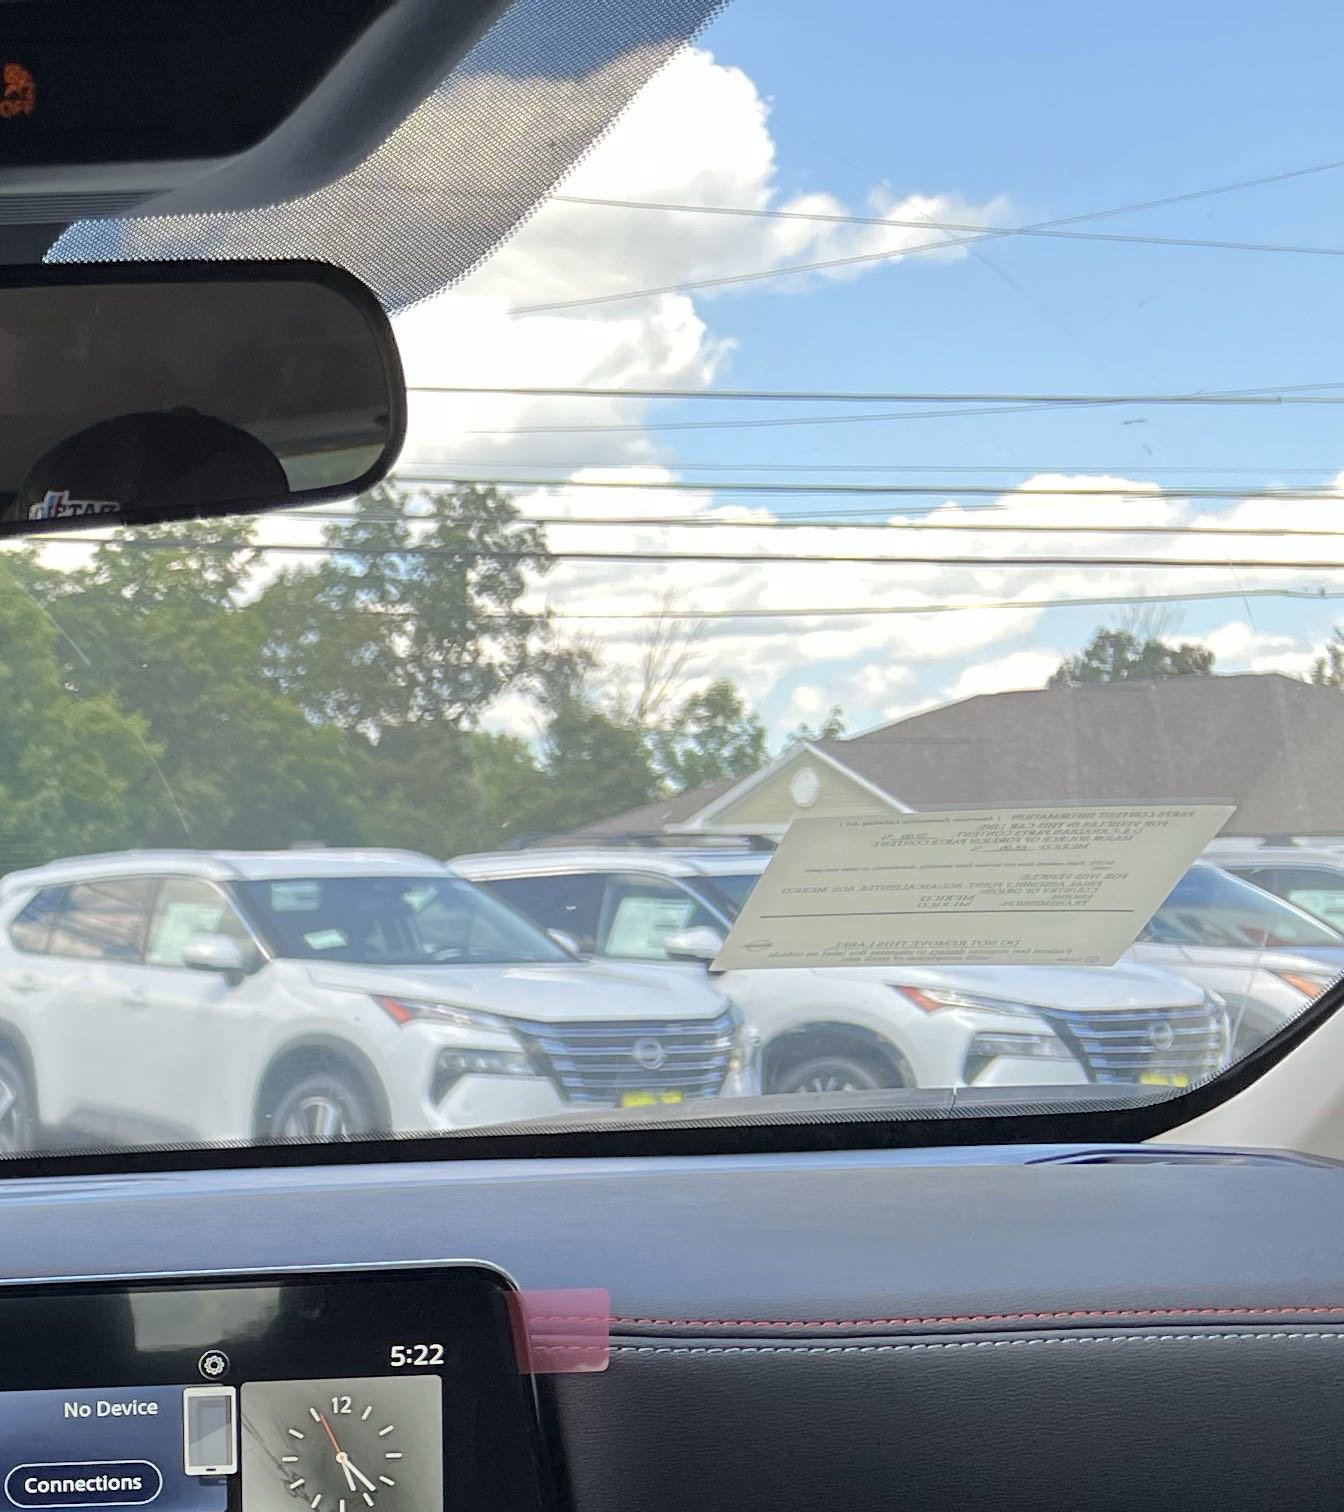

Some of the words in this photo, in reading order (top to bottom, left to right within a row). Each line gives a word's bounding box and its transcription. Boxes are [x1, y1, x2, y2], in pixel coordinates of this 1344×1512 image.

[390, 1343, 445, 1367] 5:22
[63, 1401, 92, 1418] No
[96, 1399, 159, 1417] Device
[331, 1396, 352, 1415] 12
[24, 1474, 142, 1494] Connections
